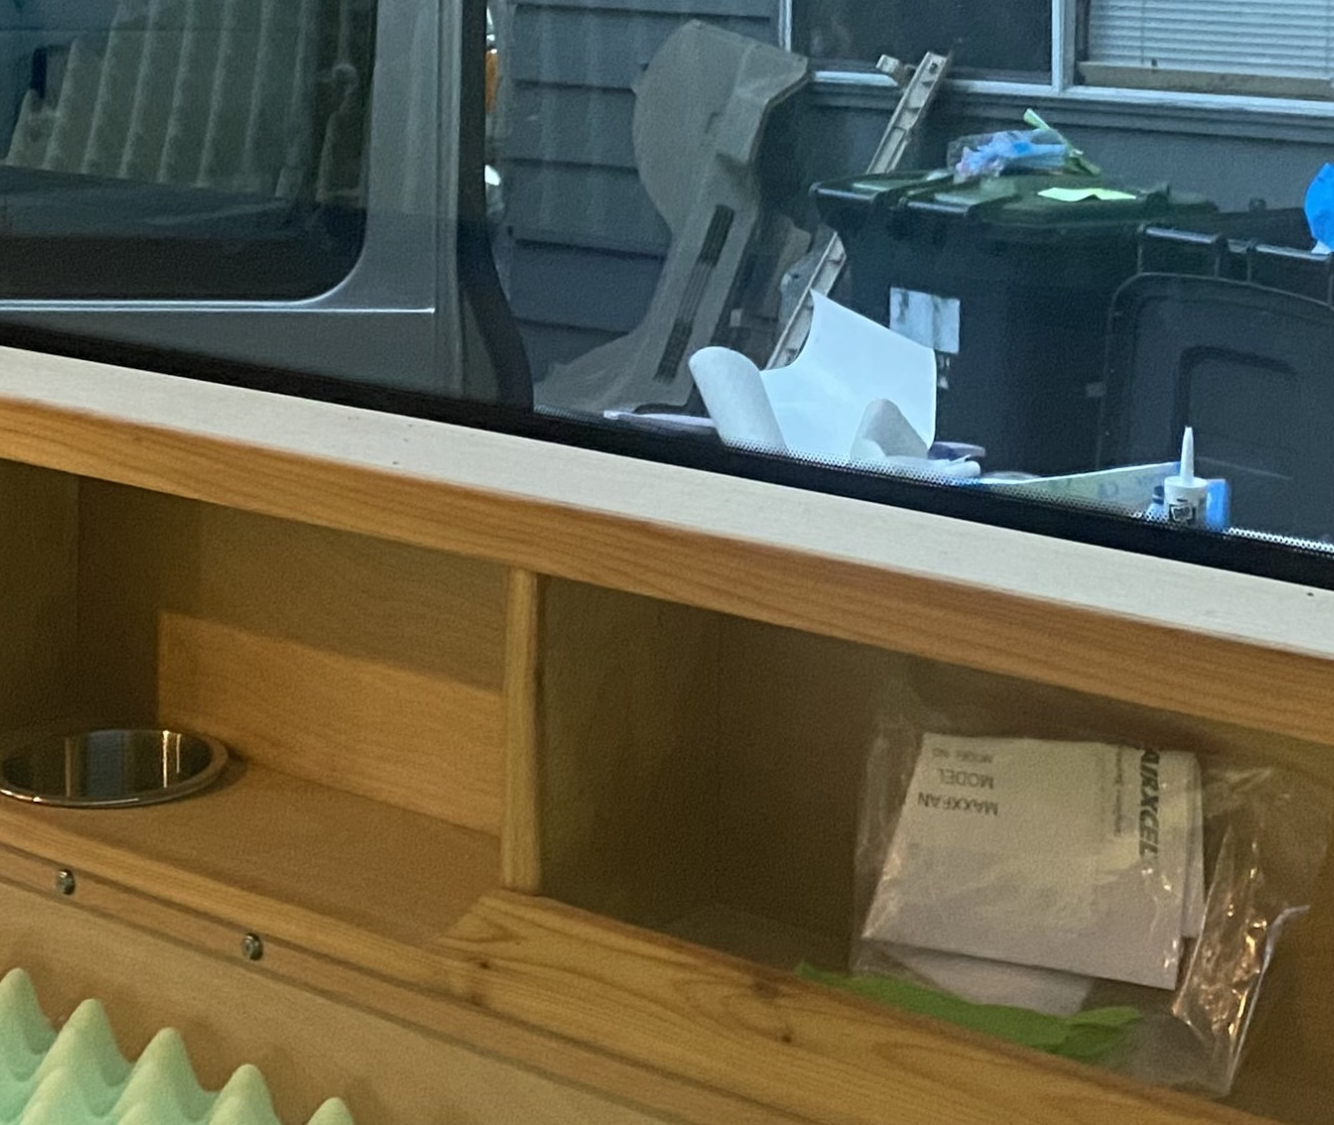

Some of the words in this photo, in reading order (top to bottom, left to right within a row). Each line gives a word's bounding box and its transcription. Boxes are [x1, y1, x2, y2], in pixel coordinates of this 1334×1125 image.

[937, 767, 995, 790] MODEL
[917, 791, 1000, 816] MAXXFAN
[1138, 748, 1159, 857] AIRXCEL
